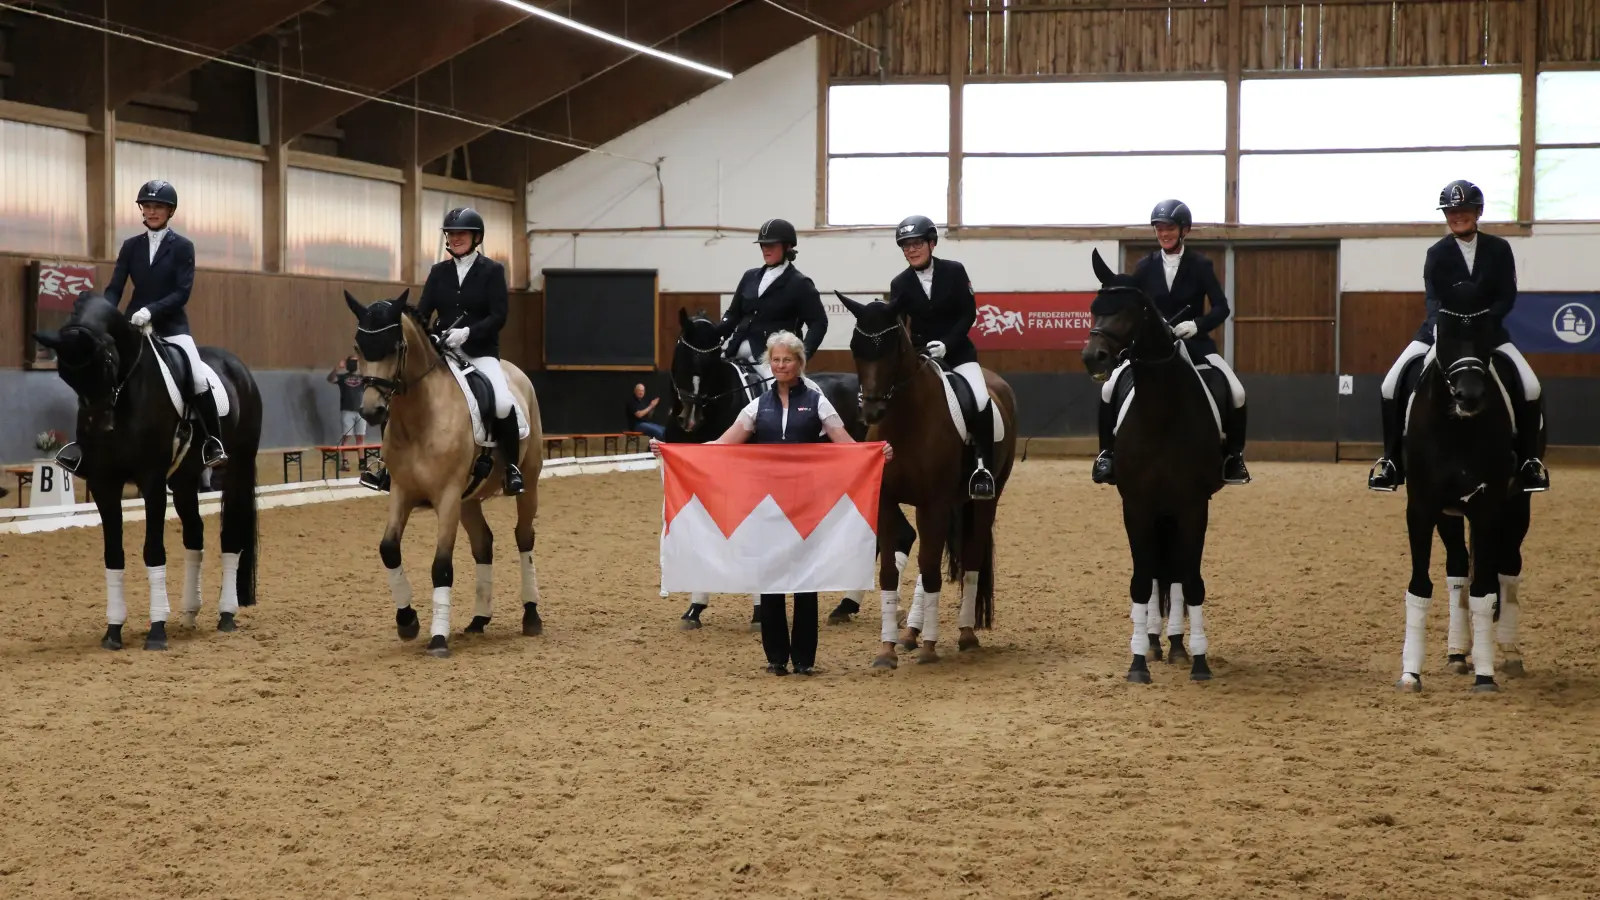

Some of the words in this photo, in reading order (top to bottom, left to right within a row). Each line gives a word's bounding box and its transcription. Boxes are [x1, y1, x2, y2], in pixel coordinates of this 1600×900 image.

[1028, 319, 1092, 328] FRANKEN
[1342, 381, 1349, 390] A
[40, 465, 54, 492] B
[63, 469, 70, 492] B
